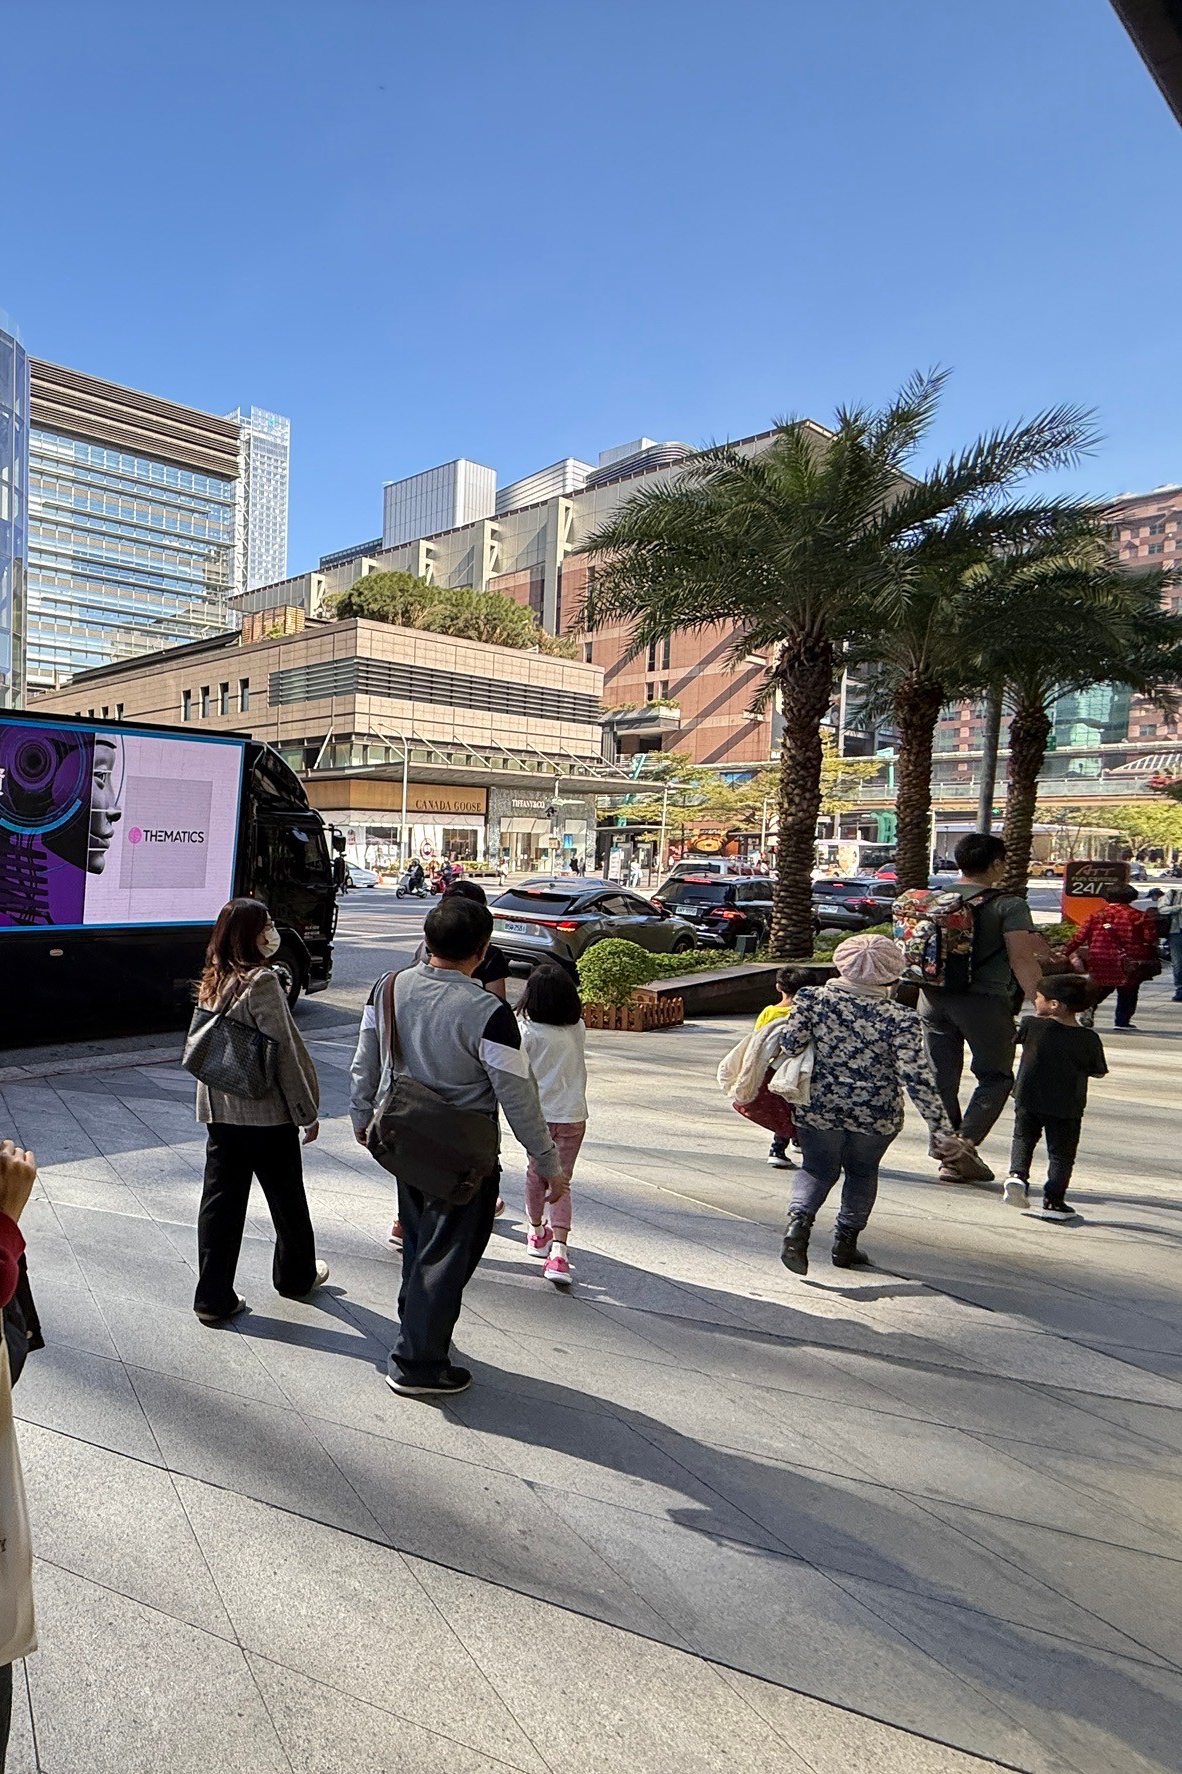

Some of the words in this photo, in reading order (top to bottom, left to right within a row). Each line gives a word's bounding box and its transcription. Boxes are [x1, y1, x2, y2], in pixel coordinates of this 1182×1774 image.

[415, 799, 451, 810] CANADA
[453, 801, 482, 812] GOOSE
[143, 829, 204, 843] THEMATICS
